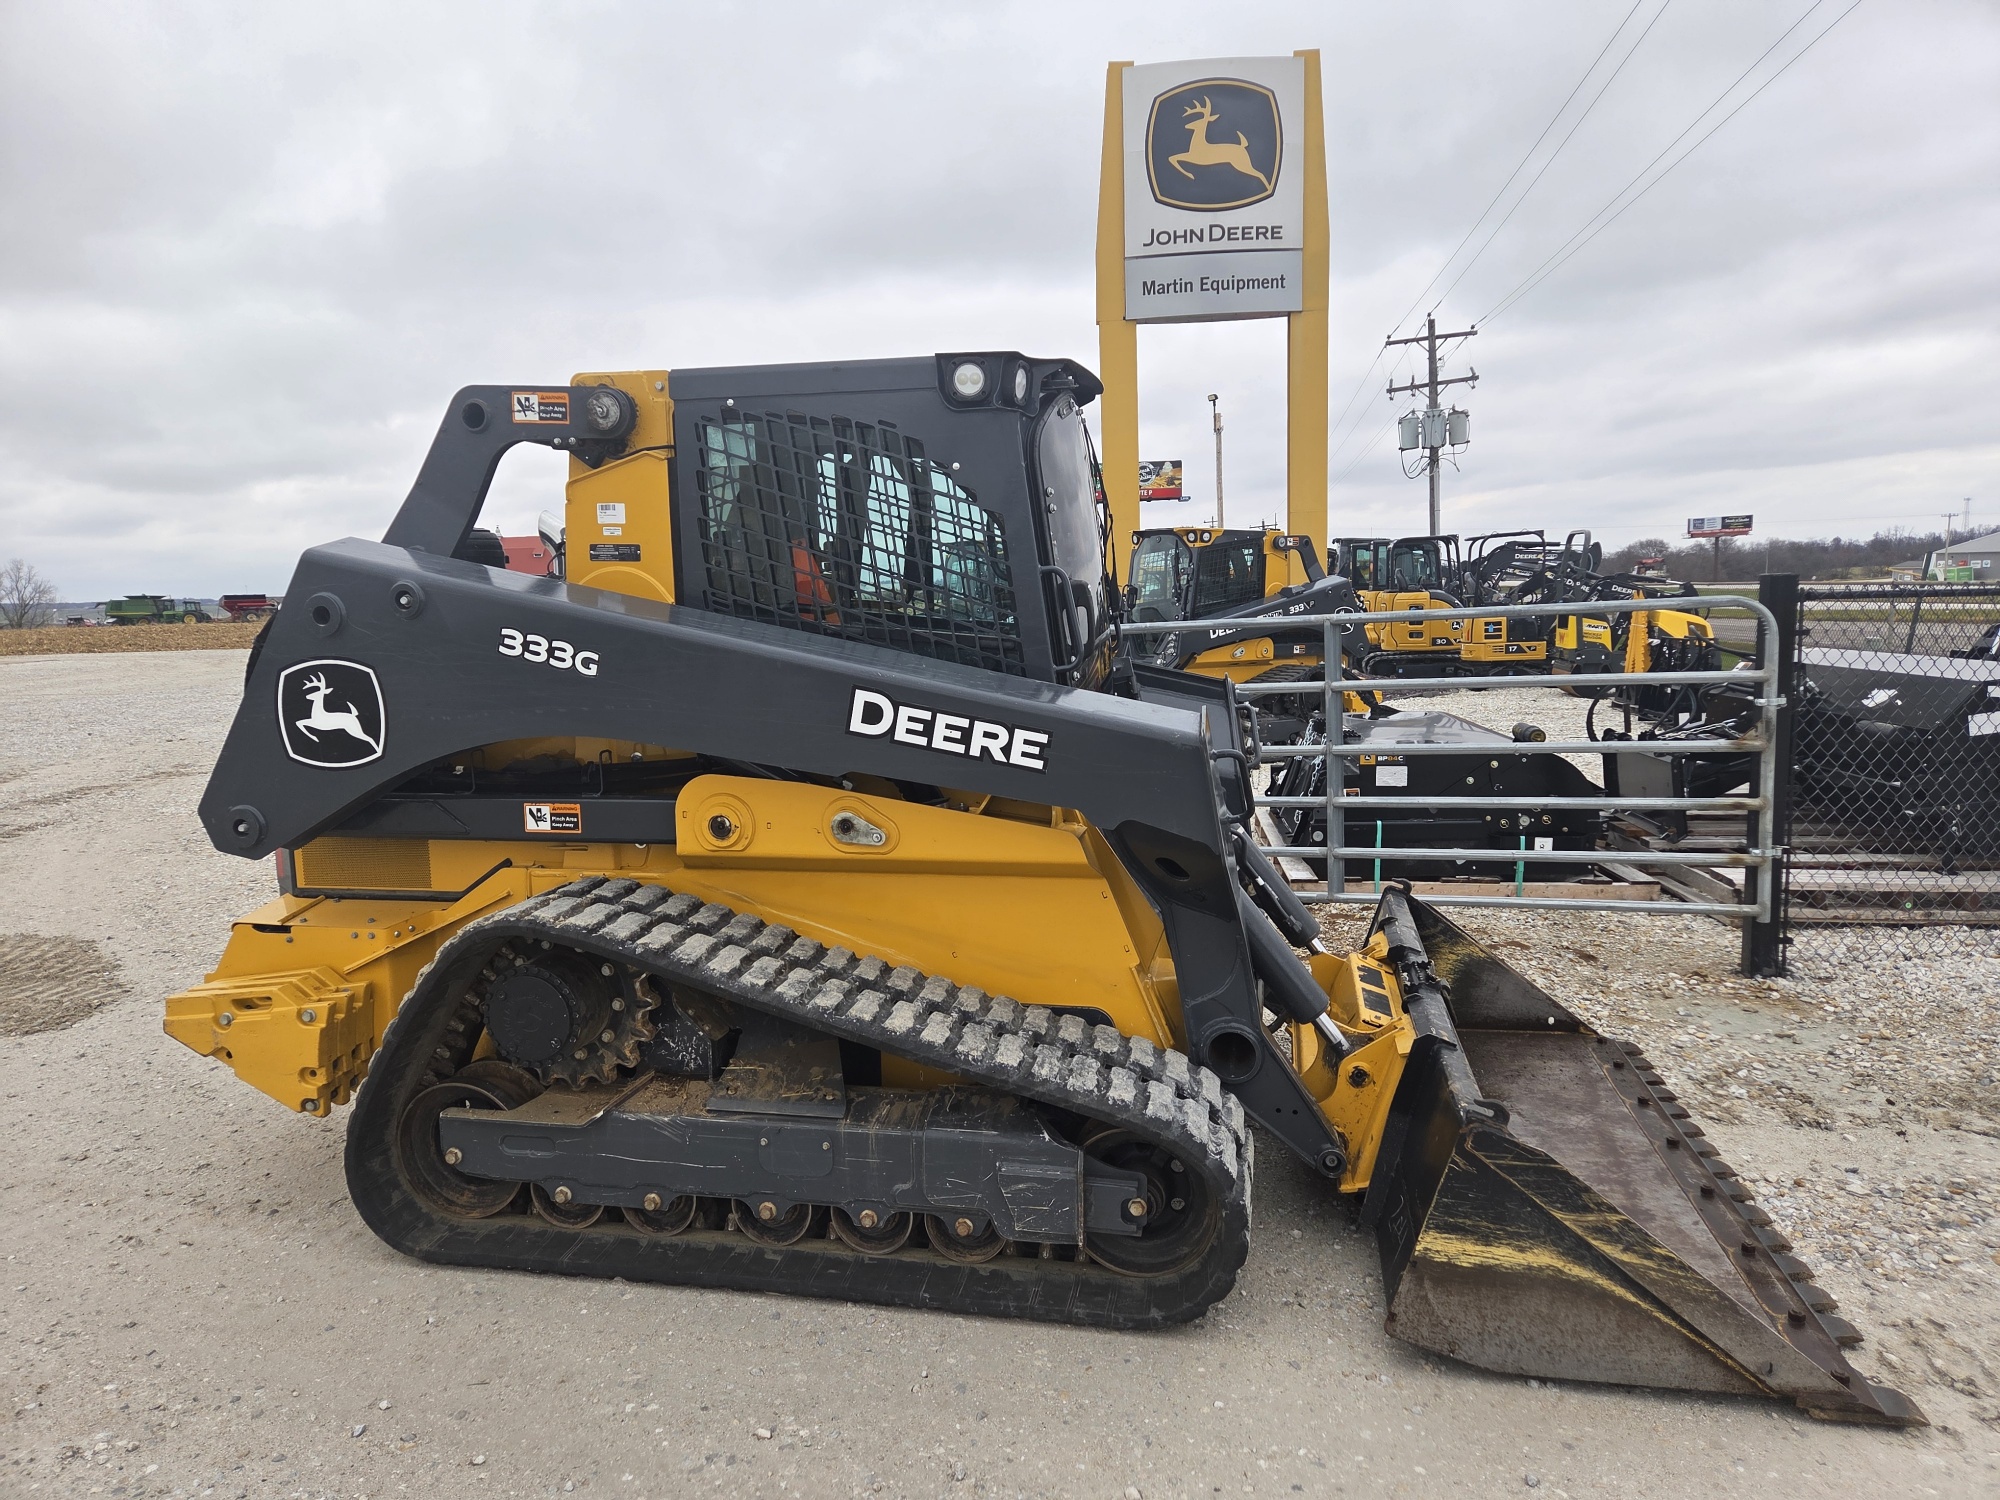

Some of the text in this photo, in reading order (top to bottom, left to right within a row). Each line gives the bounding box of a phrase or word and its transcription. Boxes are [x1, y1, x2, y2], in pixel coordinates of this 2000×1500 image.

[1142, 224, 1283, 247] JOHN DEERE
[1142, 274, 1286, 296] Martin Equipment
[498, 627, 600, 677] 333G
[849, 688, 1050, 770] DEERE
